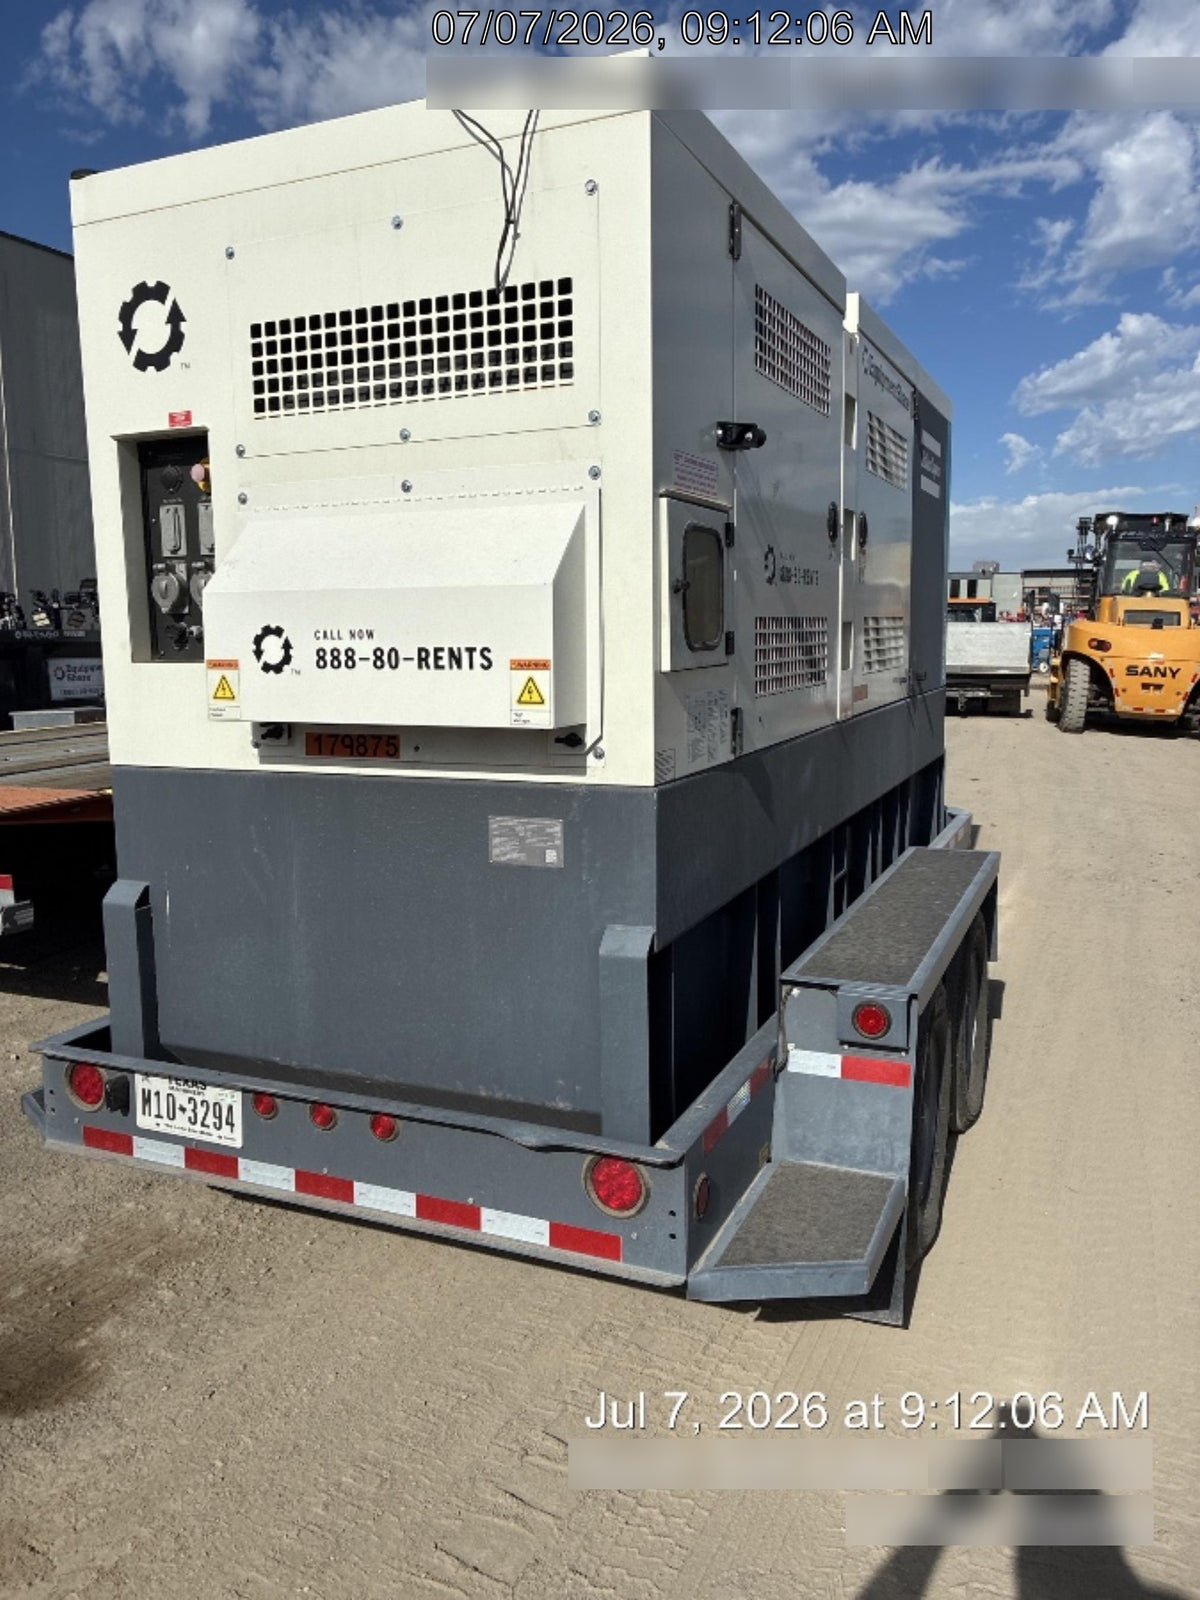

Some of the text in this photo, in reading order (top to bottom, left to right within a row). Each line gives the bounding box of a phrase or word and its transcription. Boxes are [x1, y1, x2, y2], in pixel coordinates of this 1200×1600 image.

[313, 628, 375, 641] CALL NOW
[315, 646, 493, 671] 888-80-RENTS
[1125, 664, 1181, 680] SANY
[313, 733, 399, 757] 179875
